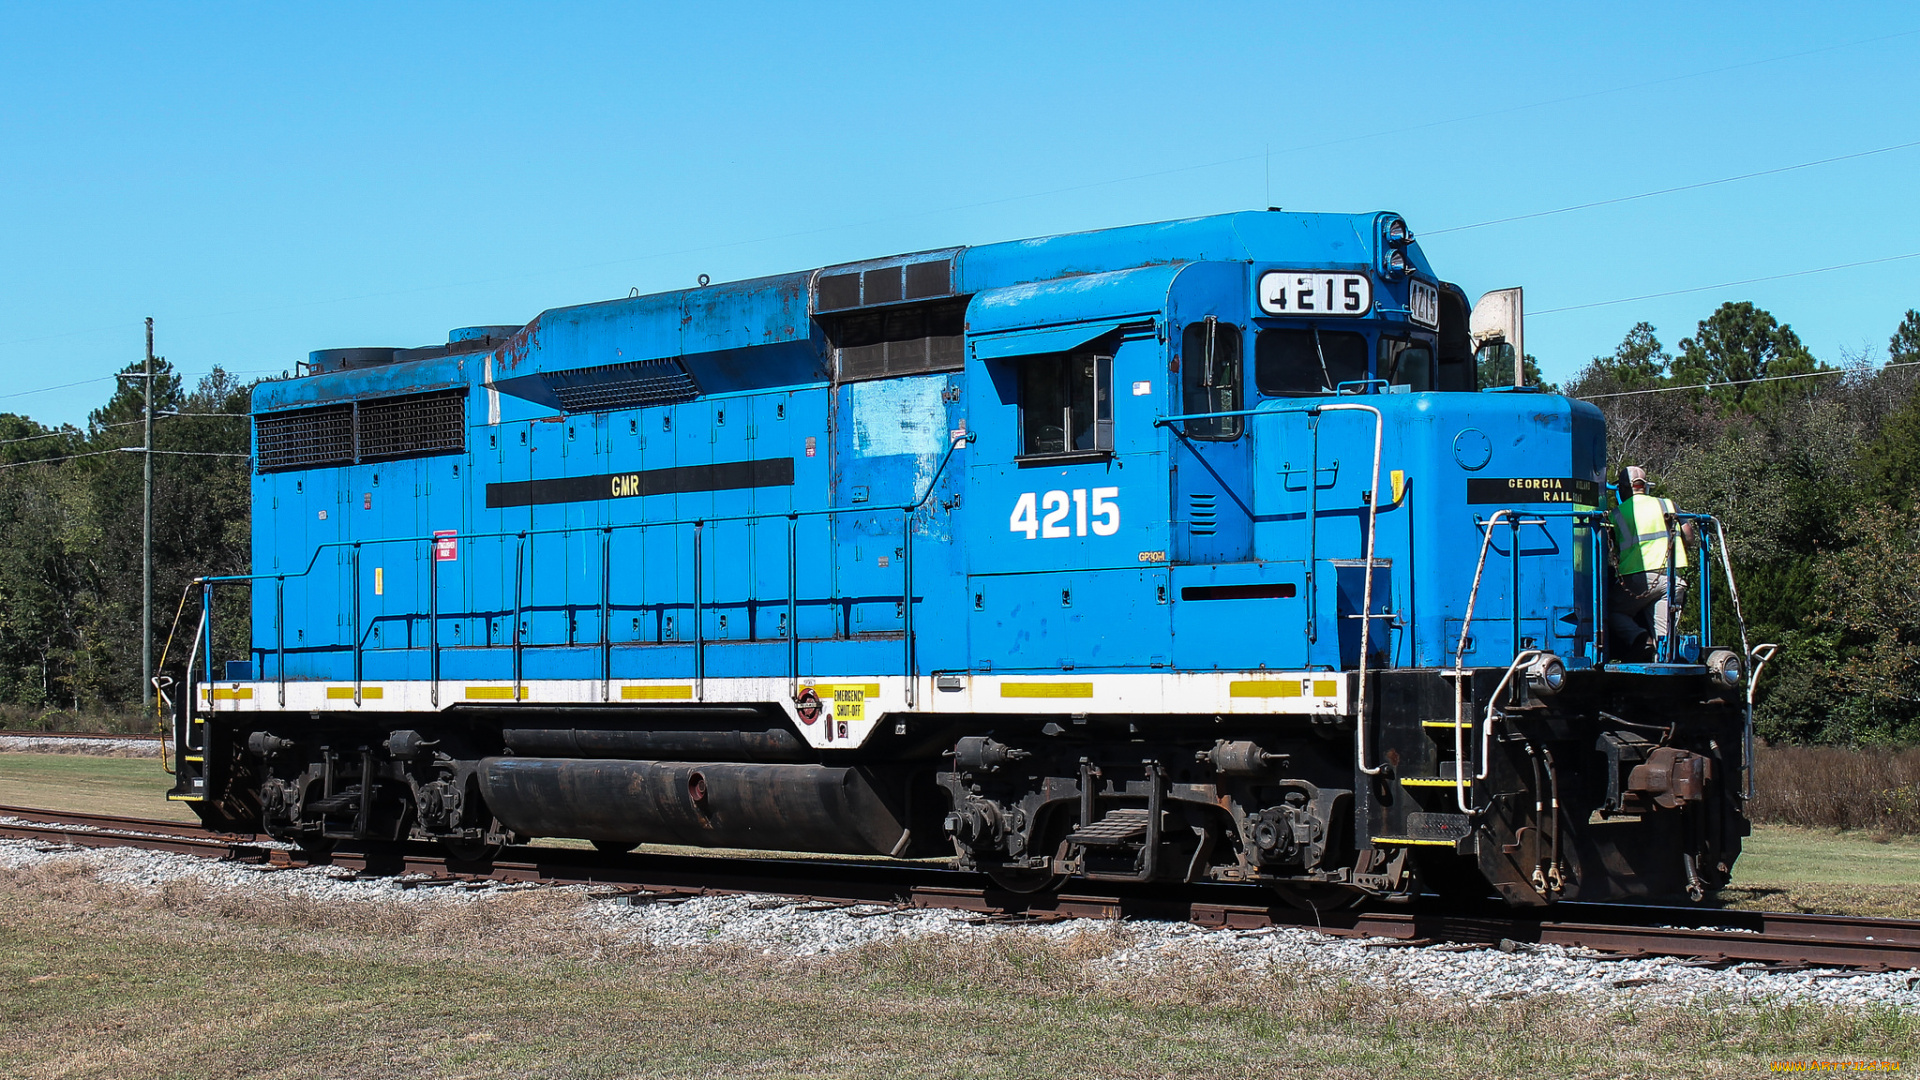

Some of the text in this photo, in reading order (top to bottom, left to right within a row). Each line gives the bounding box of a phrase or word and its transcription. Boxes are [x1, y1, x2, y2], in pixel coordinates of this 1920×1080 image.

[1269, 278, 1360, 311] 4215
[1411, 284, 1436, 323] 4215
[611, 475, 639, 497] GMR
[1508, 479, 1562, 489] GEORGIA
[1010, 486, 1120, 540] 4215
[834, 690, 864, 702] EMERGENCY
[1303, 679, 1311, 696] F
[837, 704, 861, 717] SHUT-OFF
